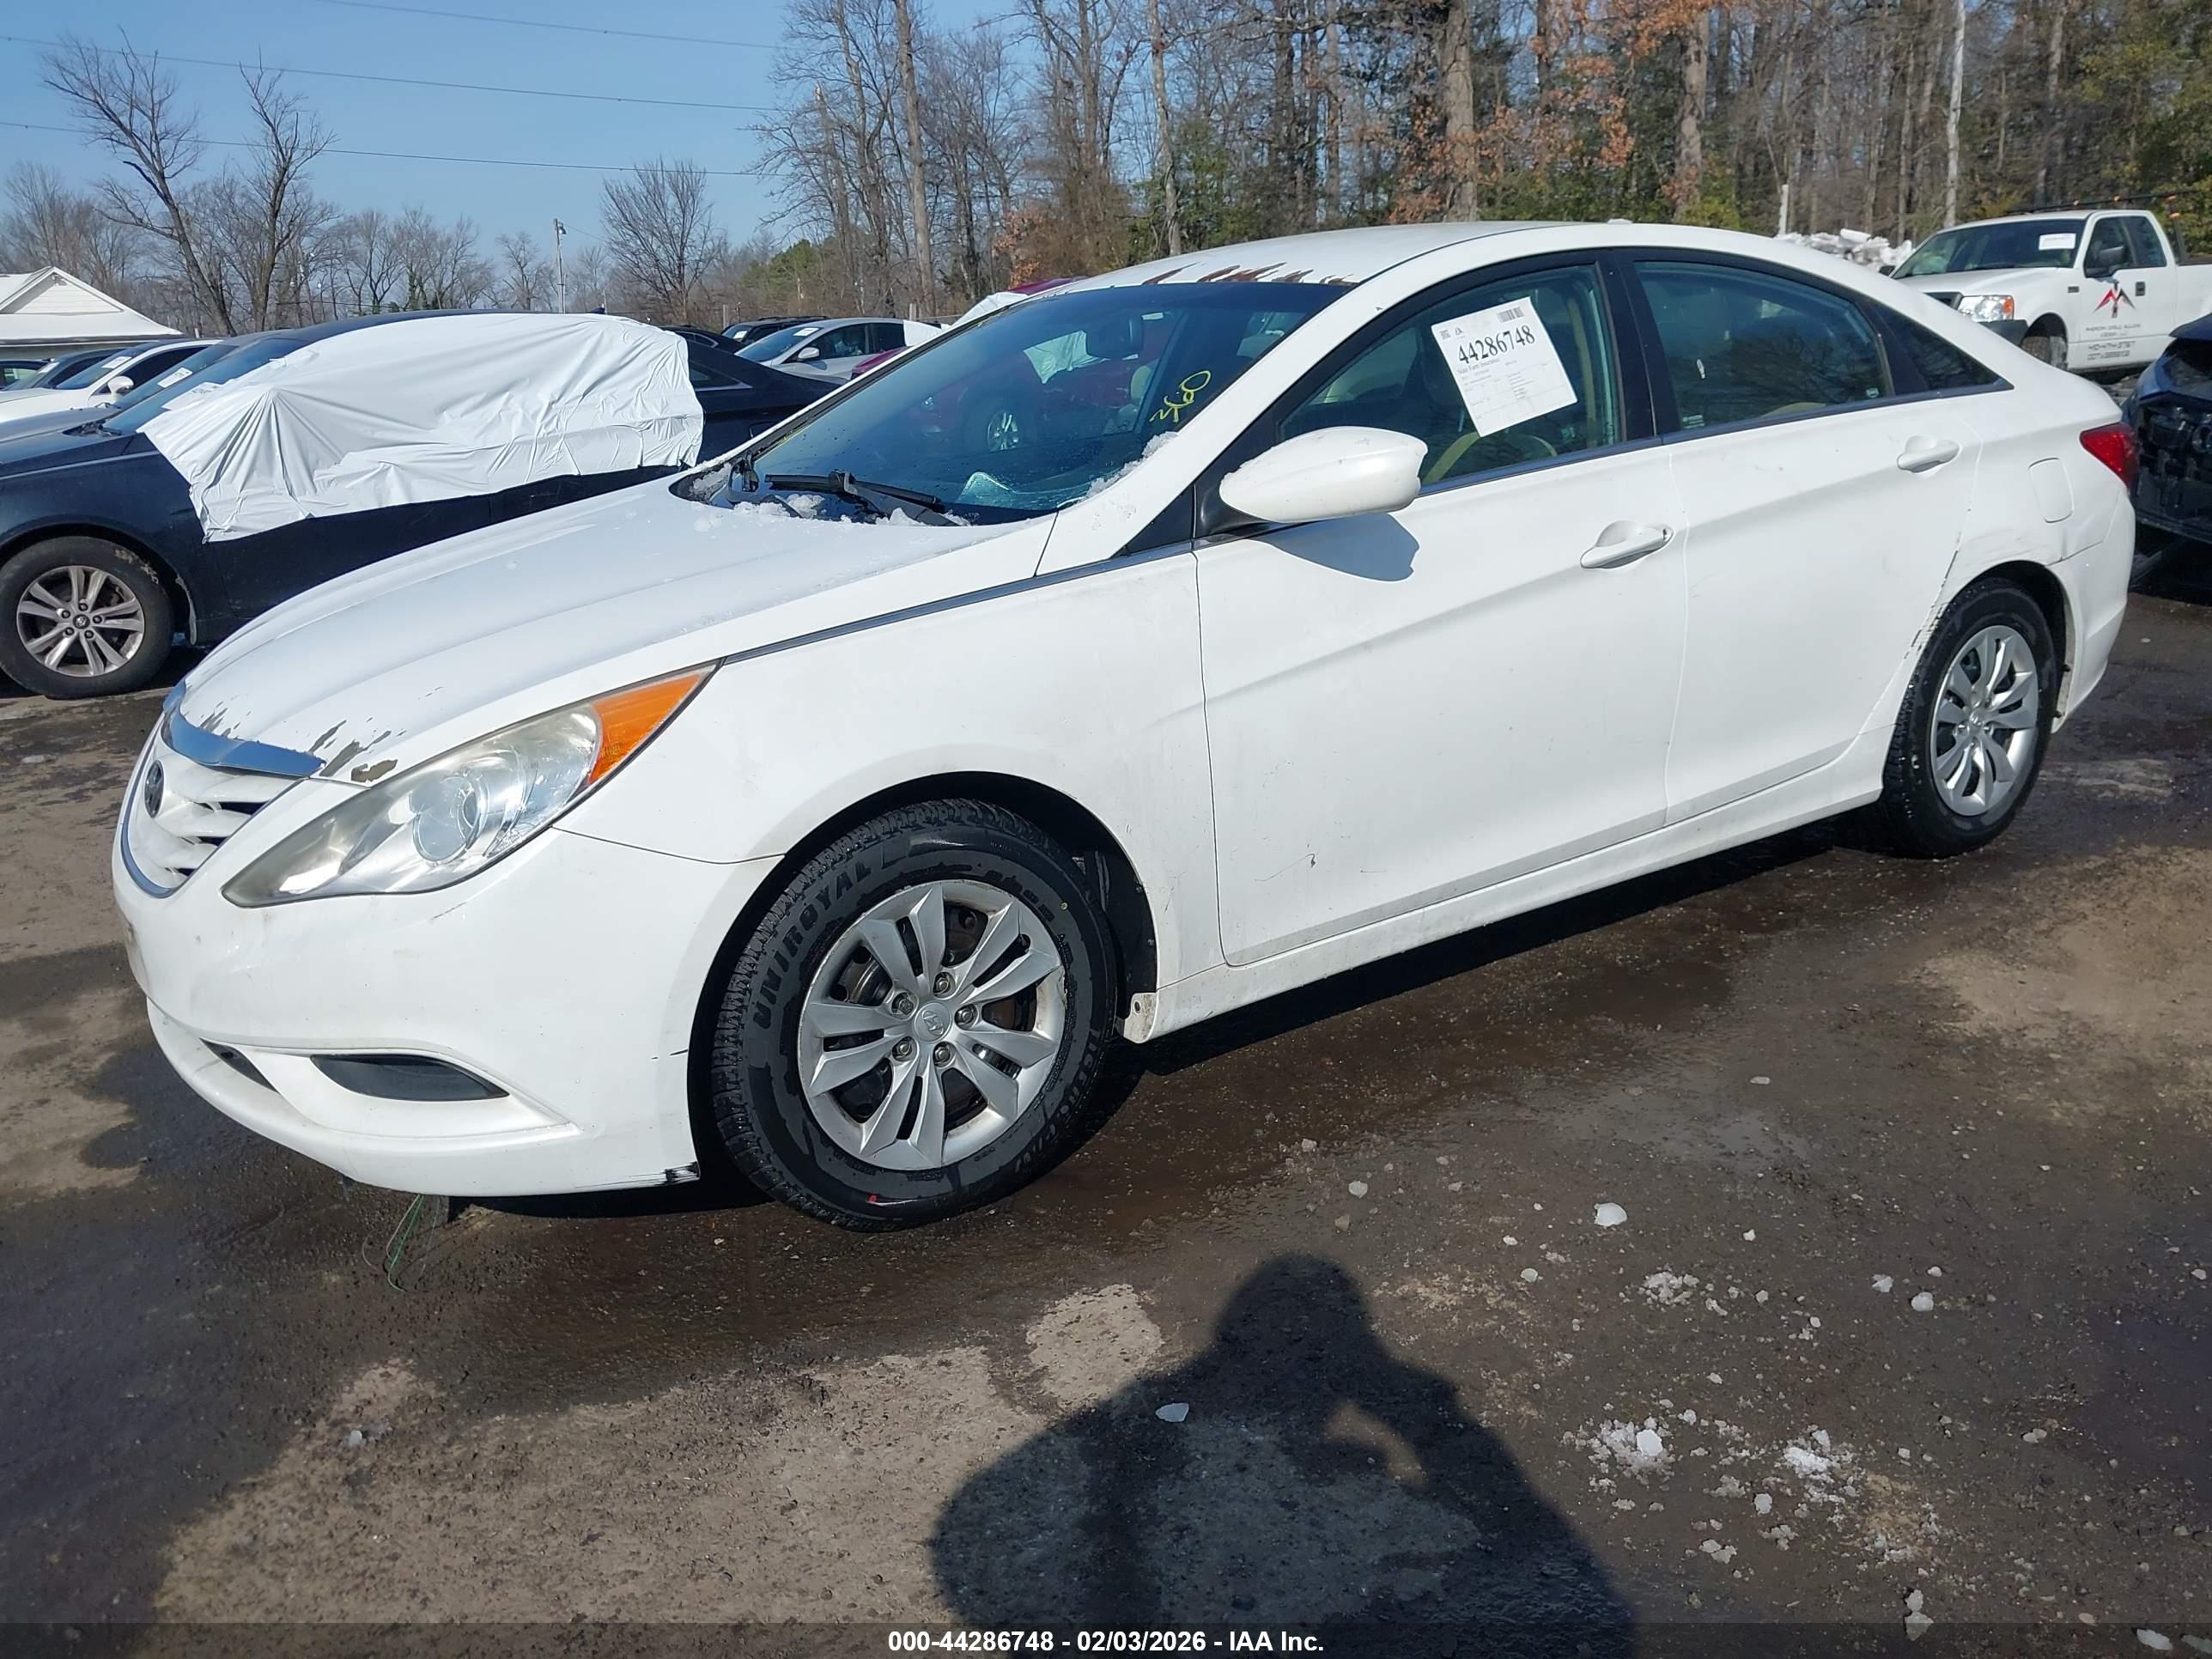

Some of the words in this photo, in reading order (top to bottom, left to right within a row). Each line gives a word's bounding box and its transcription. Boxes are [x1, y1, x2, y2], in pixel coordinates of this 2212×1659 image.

[1458, 325, 1535, 364] 44286748
[1149, 370, 1212, 423] 360
[753, 862, 872, 1030] UNIROYAL
